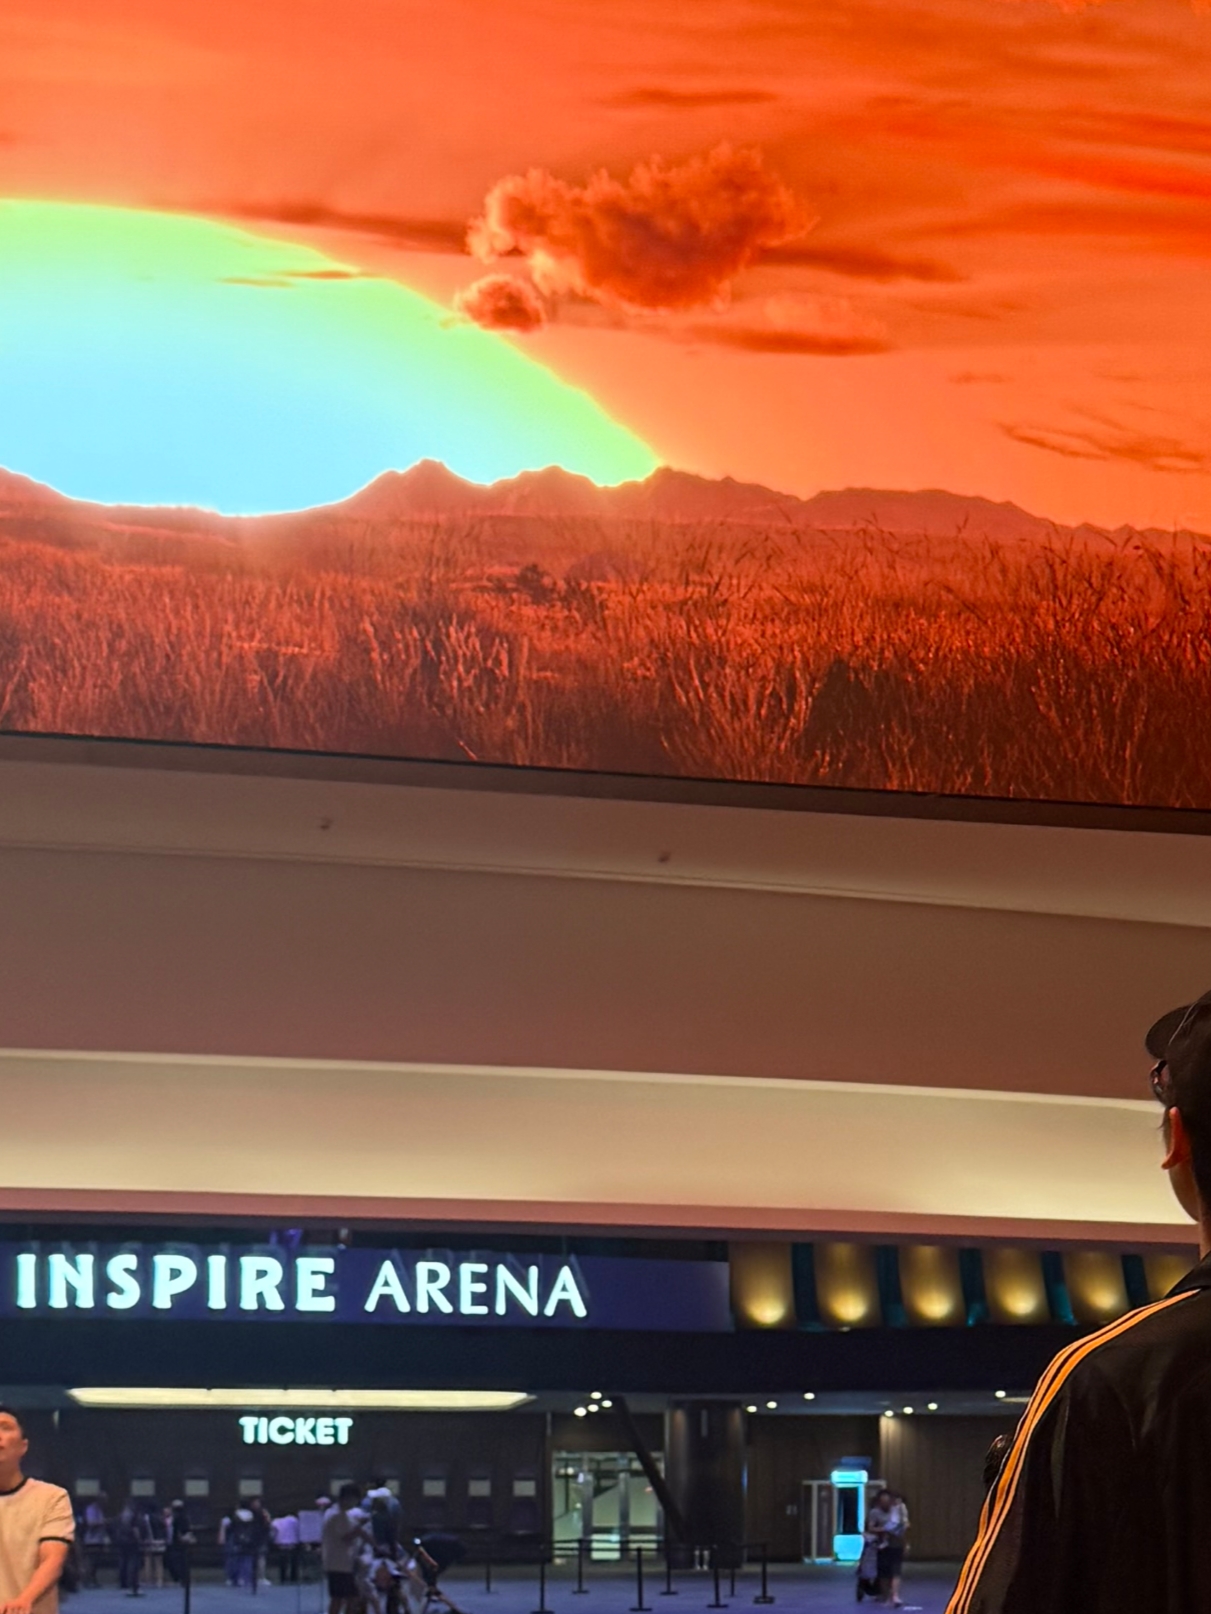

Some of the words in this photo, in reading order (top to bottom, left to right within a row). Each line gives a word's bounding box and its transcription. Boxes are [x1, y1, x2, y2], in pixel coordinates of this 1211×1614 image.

[15, 1253, 335, 1311] INSPIRE
[363, 1259, 587, 1317] ARENA
[238, 1416, 353, 1445] TICKET
